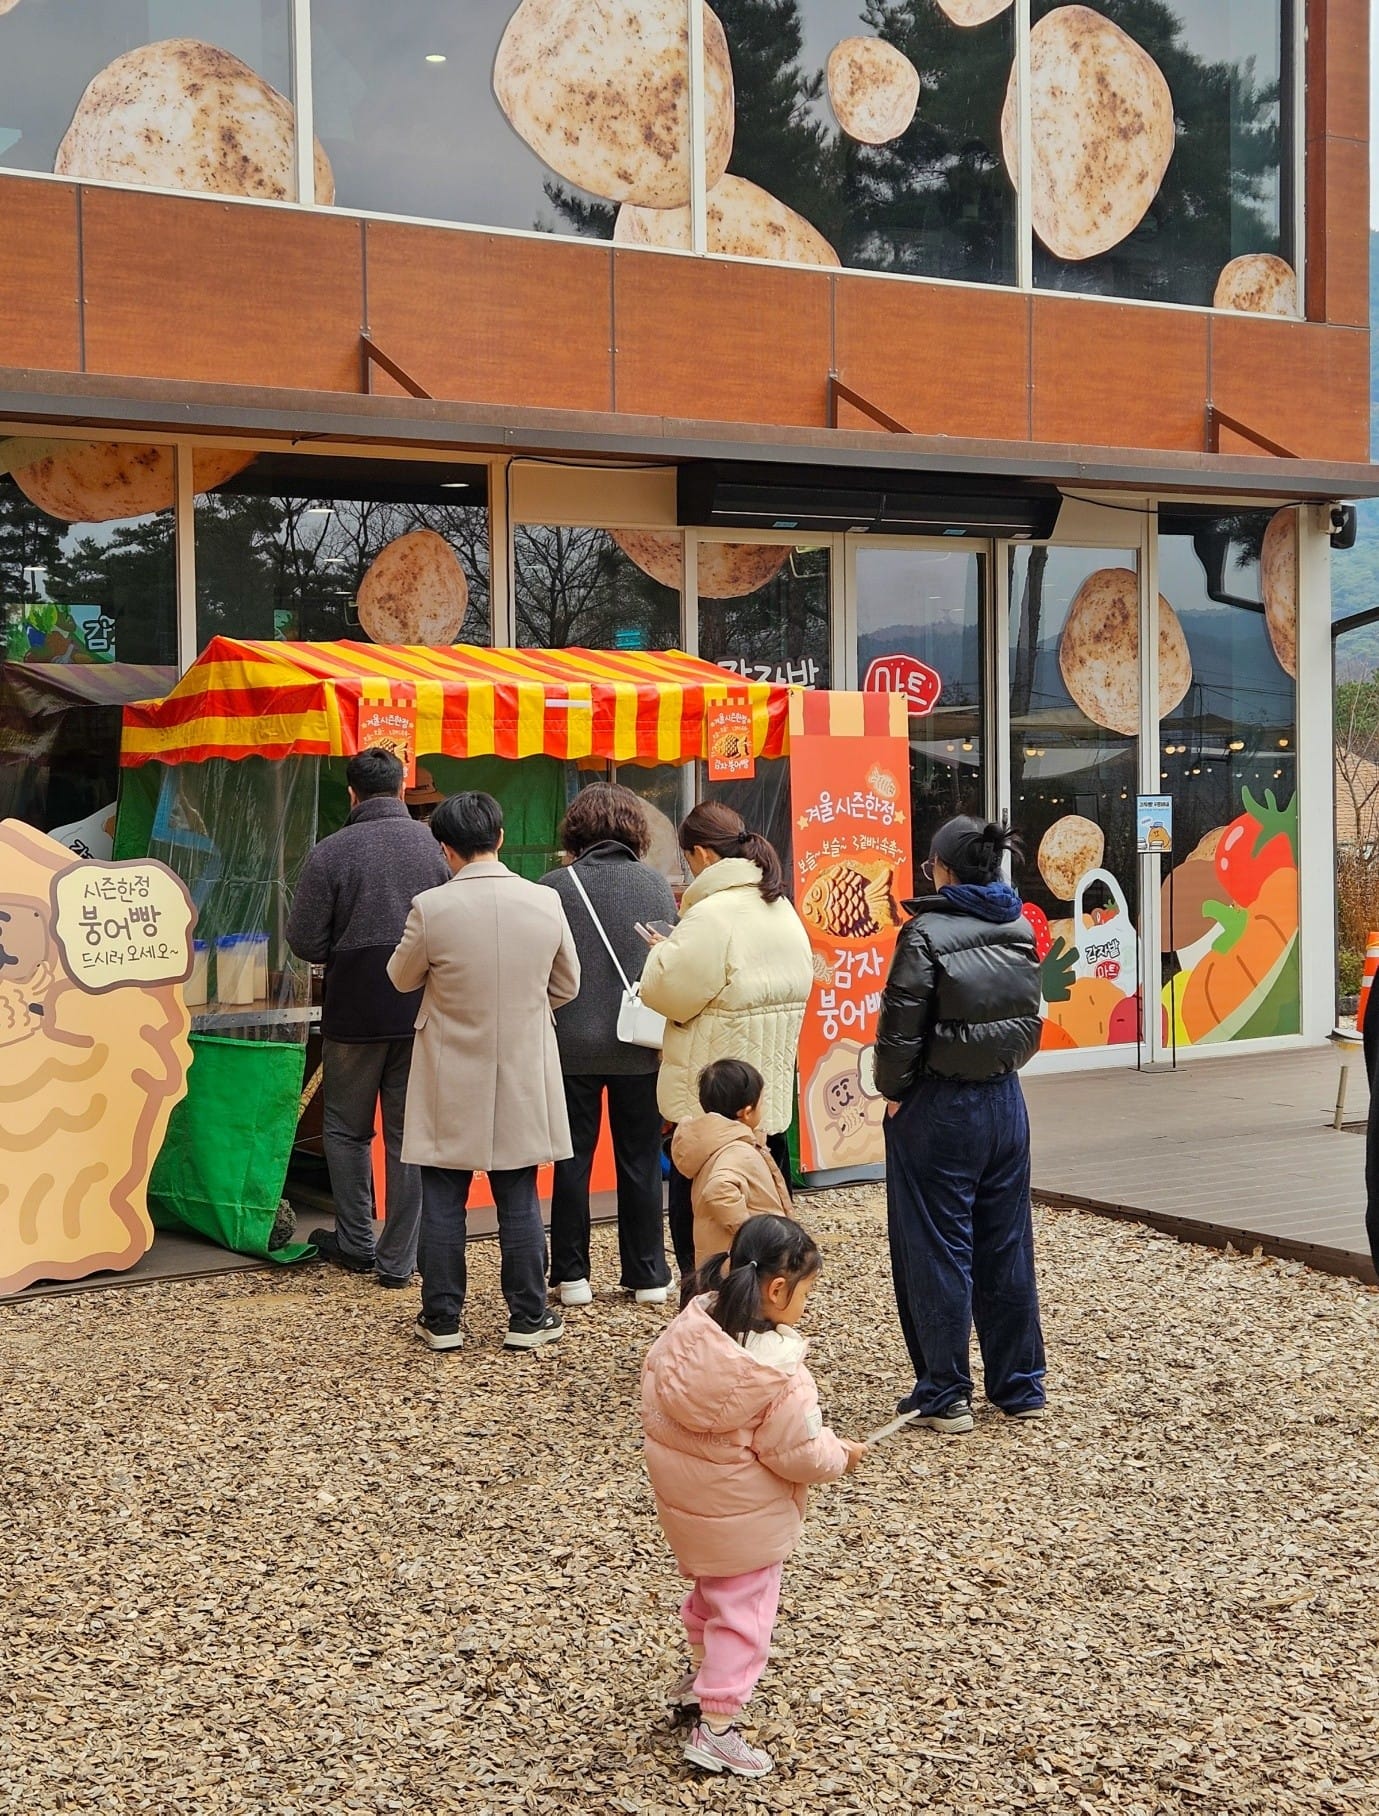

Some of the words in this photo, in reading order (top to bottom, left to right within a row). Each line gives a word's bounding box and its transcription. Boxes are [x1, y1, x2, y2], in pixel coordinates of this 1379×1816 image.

[83, 618, 115, 651] 감
[83, 875, 150, 903] 시즌한정
[78, 904, 162, 946] 붕어빵
[82, 950, 124, 969] 드시러
[832, 947, 885, 989] 감자
